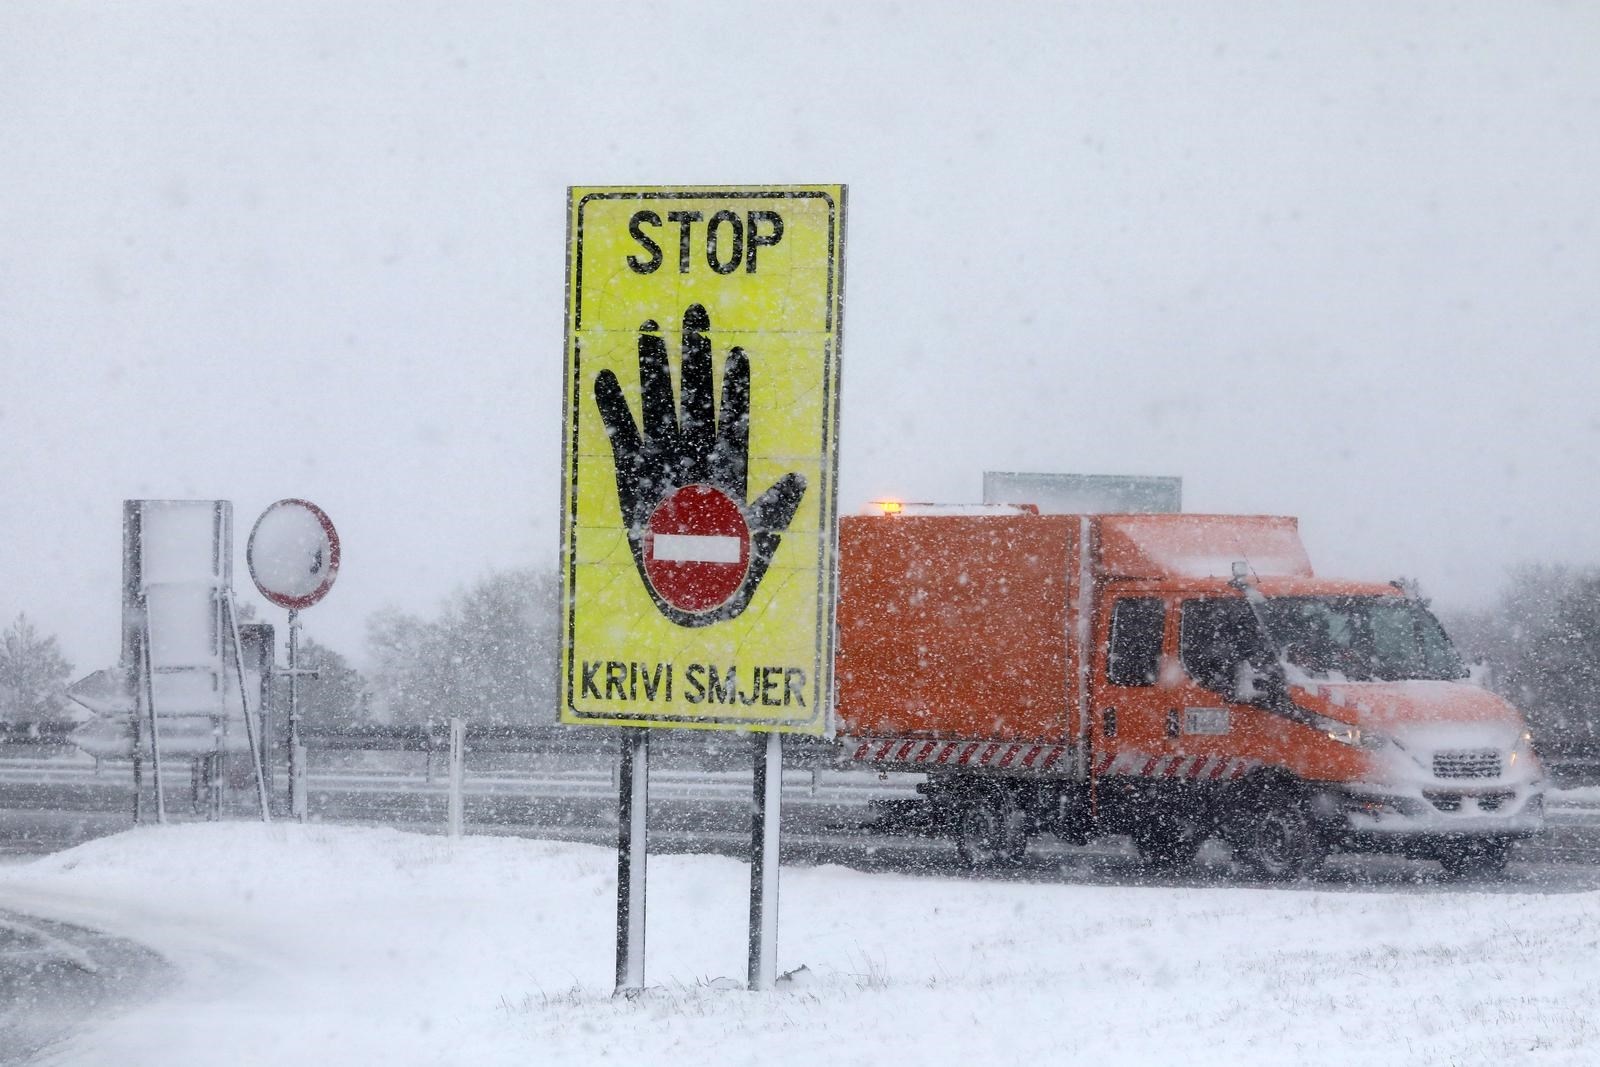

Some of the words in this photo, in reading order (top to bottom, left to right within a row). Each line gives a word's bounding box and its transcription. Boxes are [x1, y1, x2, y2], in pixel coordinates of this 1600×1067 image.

[626, 209, 785, 275] STOP
[581, 660, 673, 702] KRIVI
[684, 663, 807, 707] SMJER
